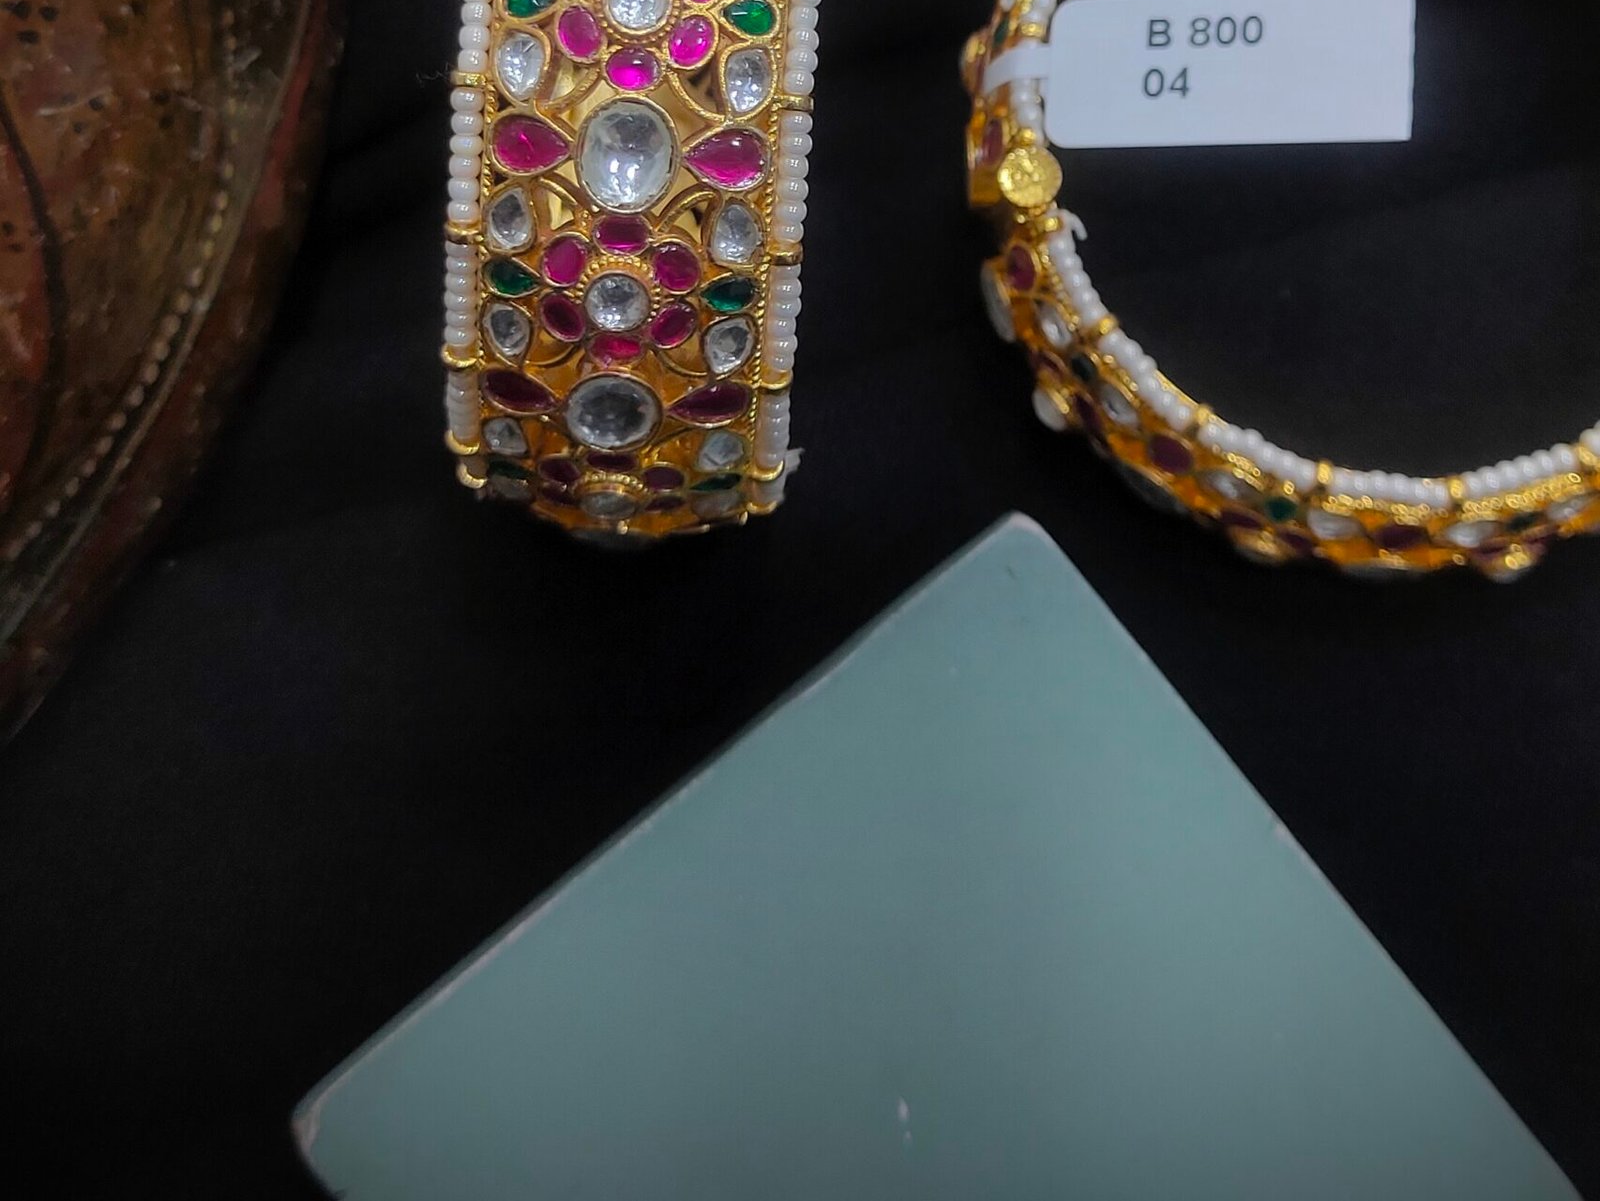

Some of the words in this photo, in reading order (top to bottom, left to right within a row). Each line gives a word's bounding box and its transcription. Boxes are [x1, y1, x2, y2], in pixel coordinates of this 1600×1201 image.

[1148, 19, 1171, 47] B
[1190, 16, 1263, 46] 800
[1144, 67, 1189, 97] 04
